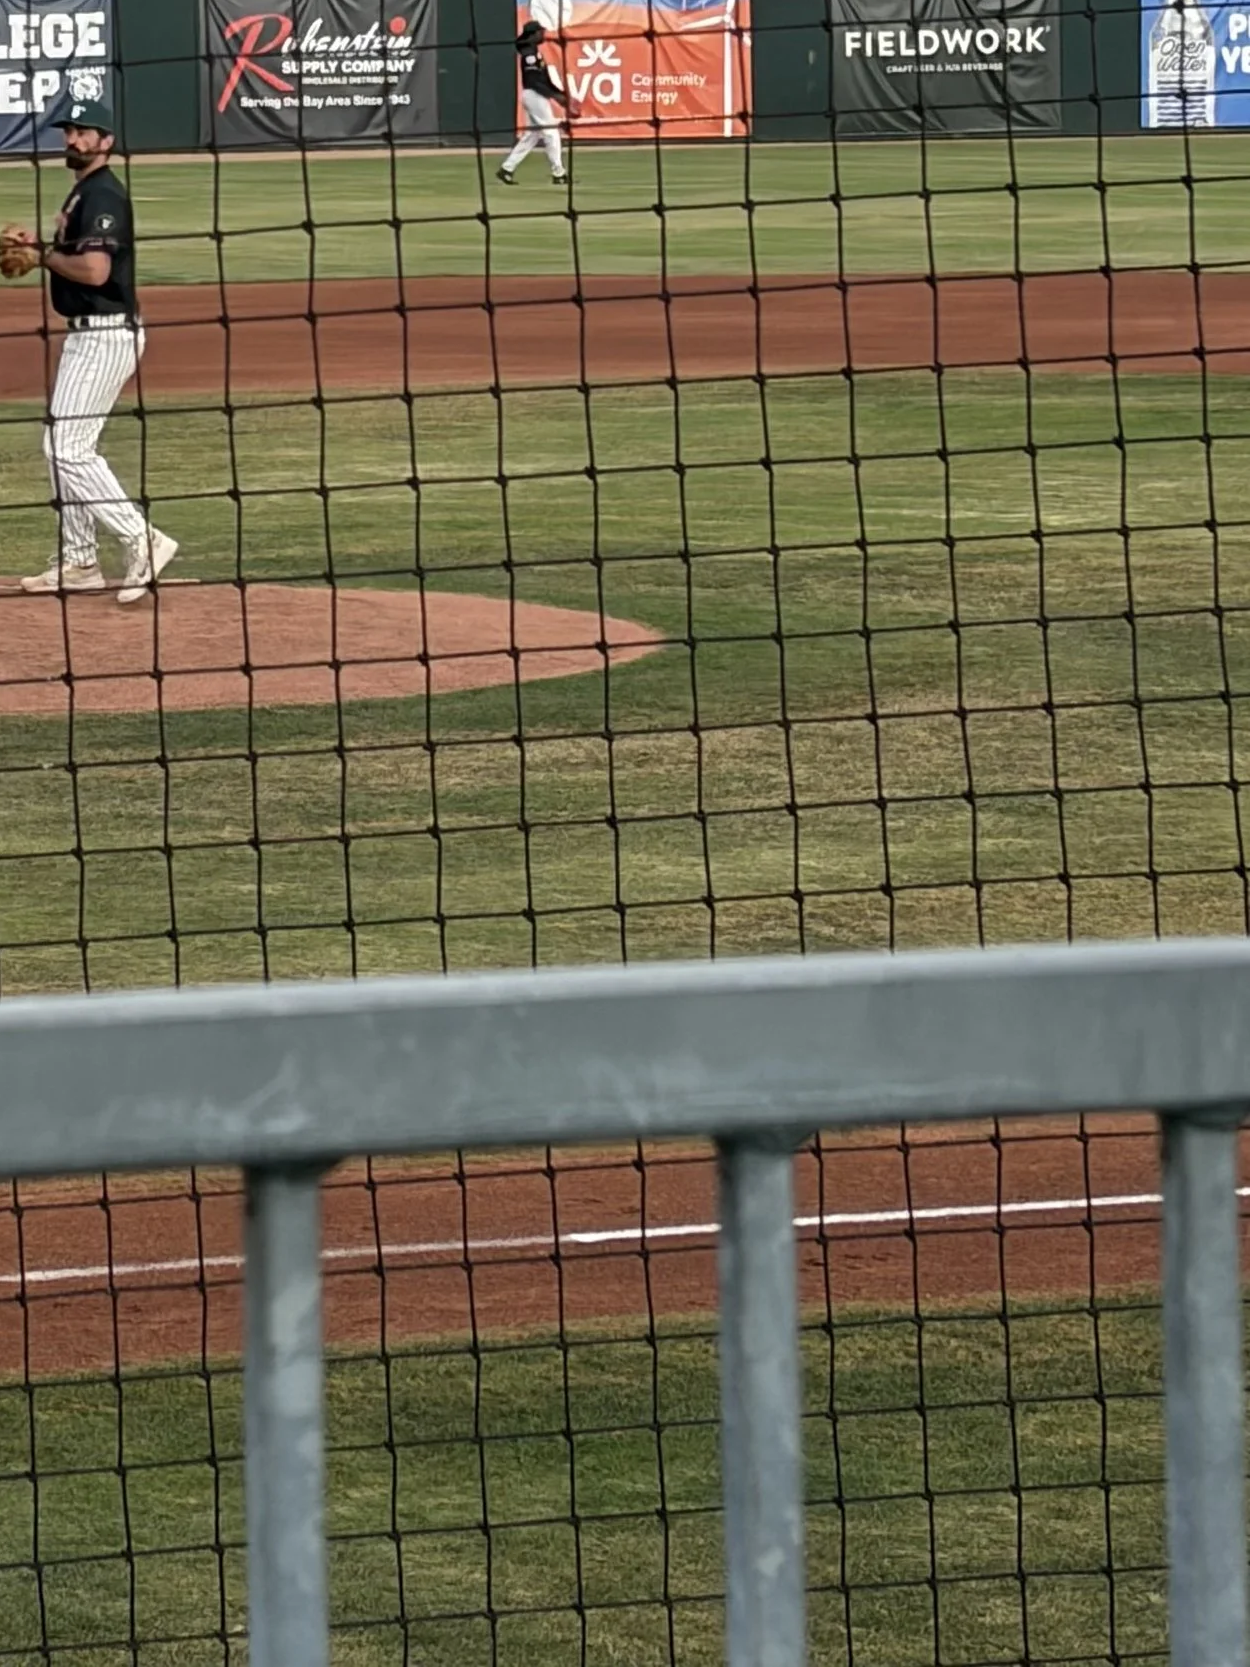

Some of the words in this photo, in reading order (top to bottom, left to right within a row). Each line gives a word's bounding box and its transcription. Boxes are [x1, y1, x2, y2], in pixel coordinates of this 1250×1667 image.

[845, 26, 1047, 57] FIELDWORK
[281, 60, 338, 75] SUPPLY
[341, 58, 416, 74] COMPANY
[349, 75, 399, 84] DISTRIBUOR
[240, 96, 282, 110] Serving
[302, 95, 324, 110] Bay
[325, 95, 351, 107] Area
[353, 95, 384, 107] Since
[388, 94, 411, 106] 943
[631, 90, 679, 106] Enrgy
